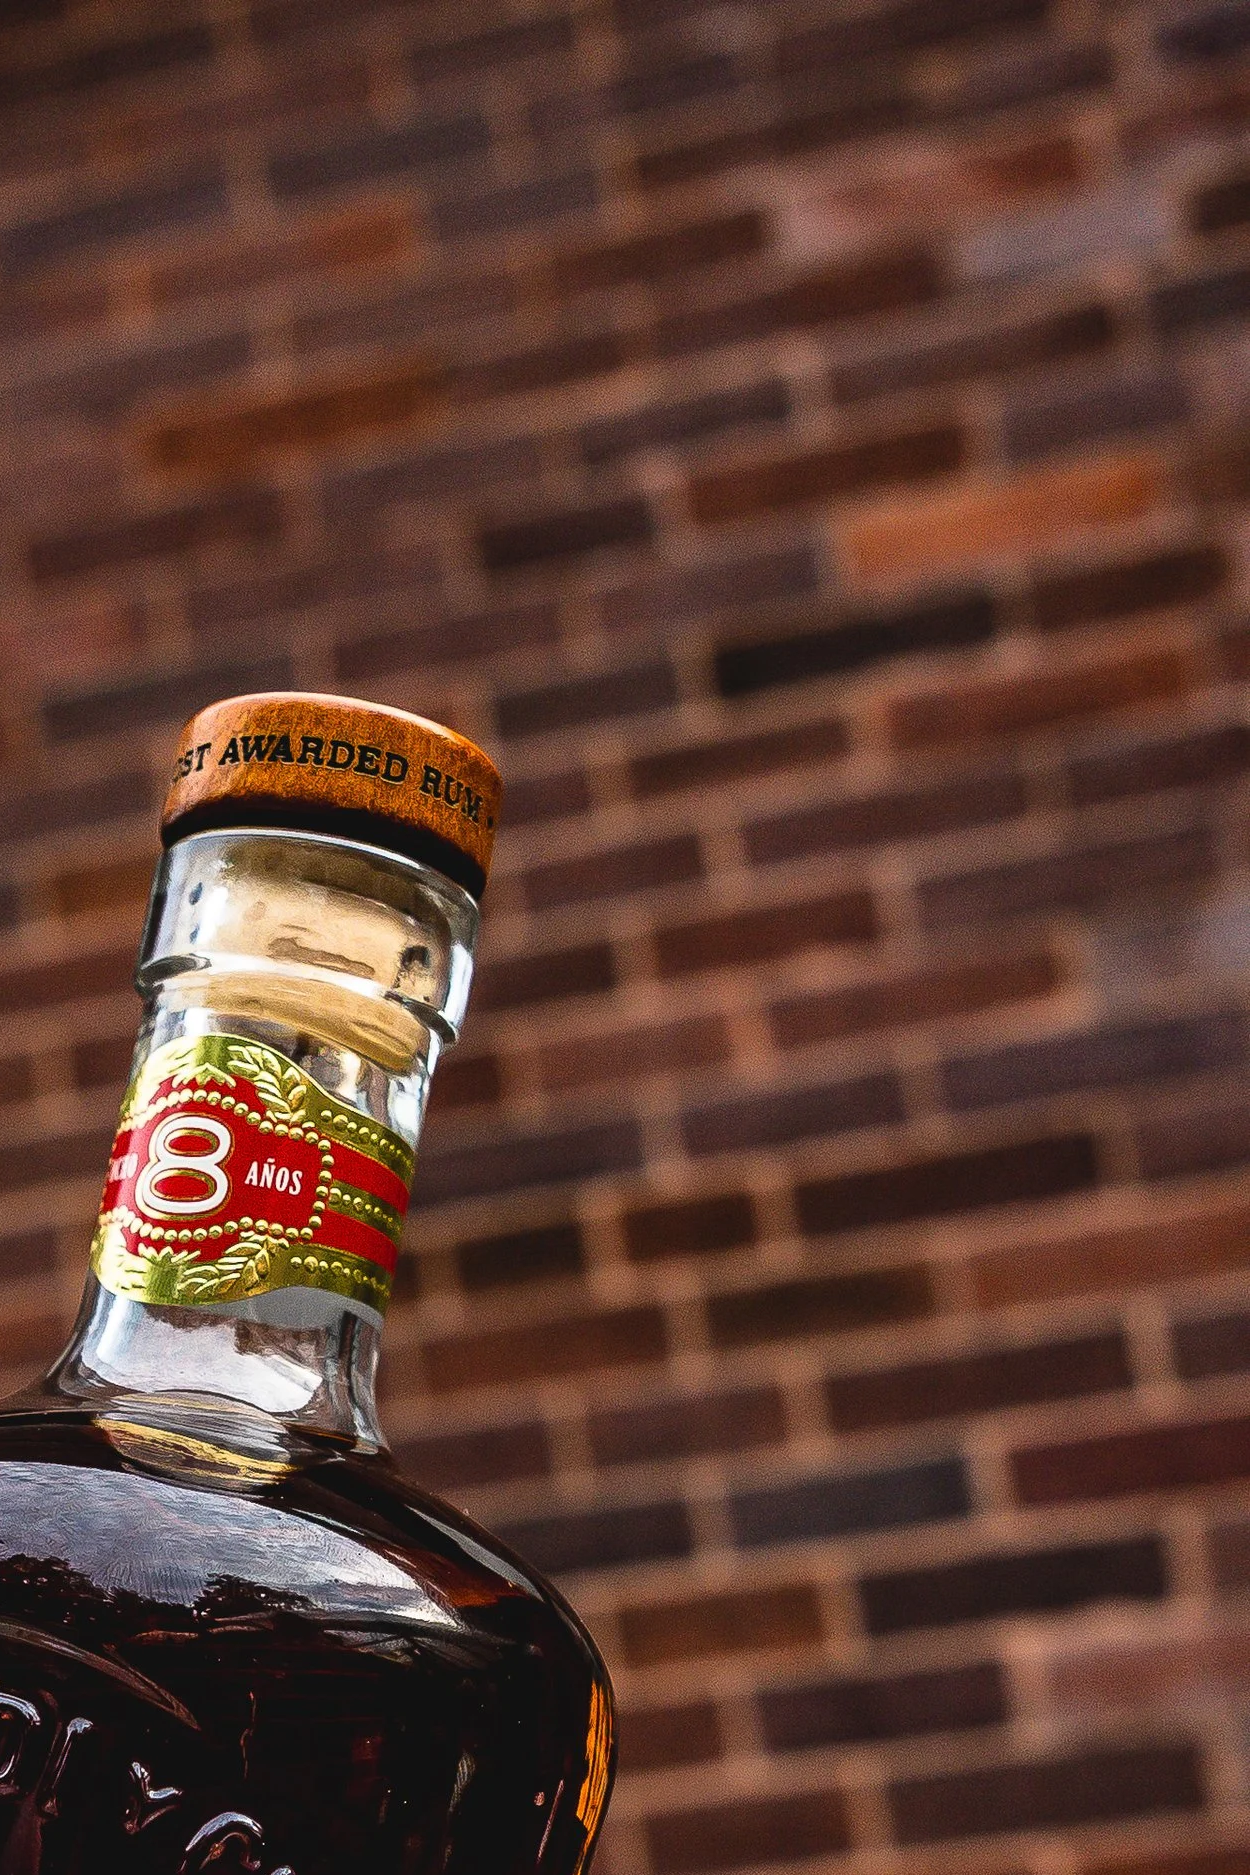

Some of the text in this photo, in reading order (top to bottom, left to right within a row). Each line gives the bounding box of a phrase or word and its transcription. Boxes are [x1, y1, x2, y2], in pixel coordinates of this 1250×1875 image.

[172, 733, 483, 824] ST AWARDED RUM
[134, 1112, 236, 1222] 8
[244, 1157, 304, 1197] AÑOS
